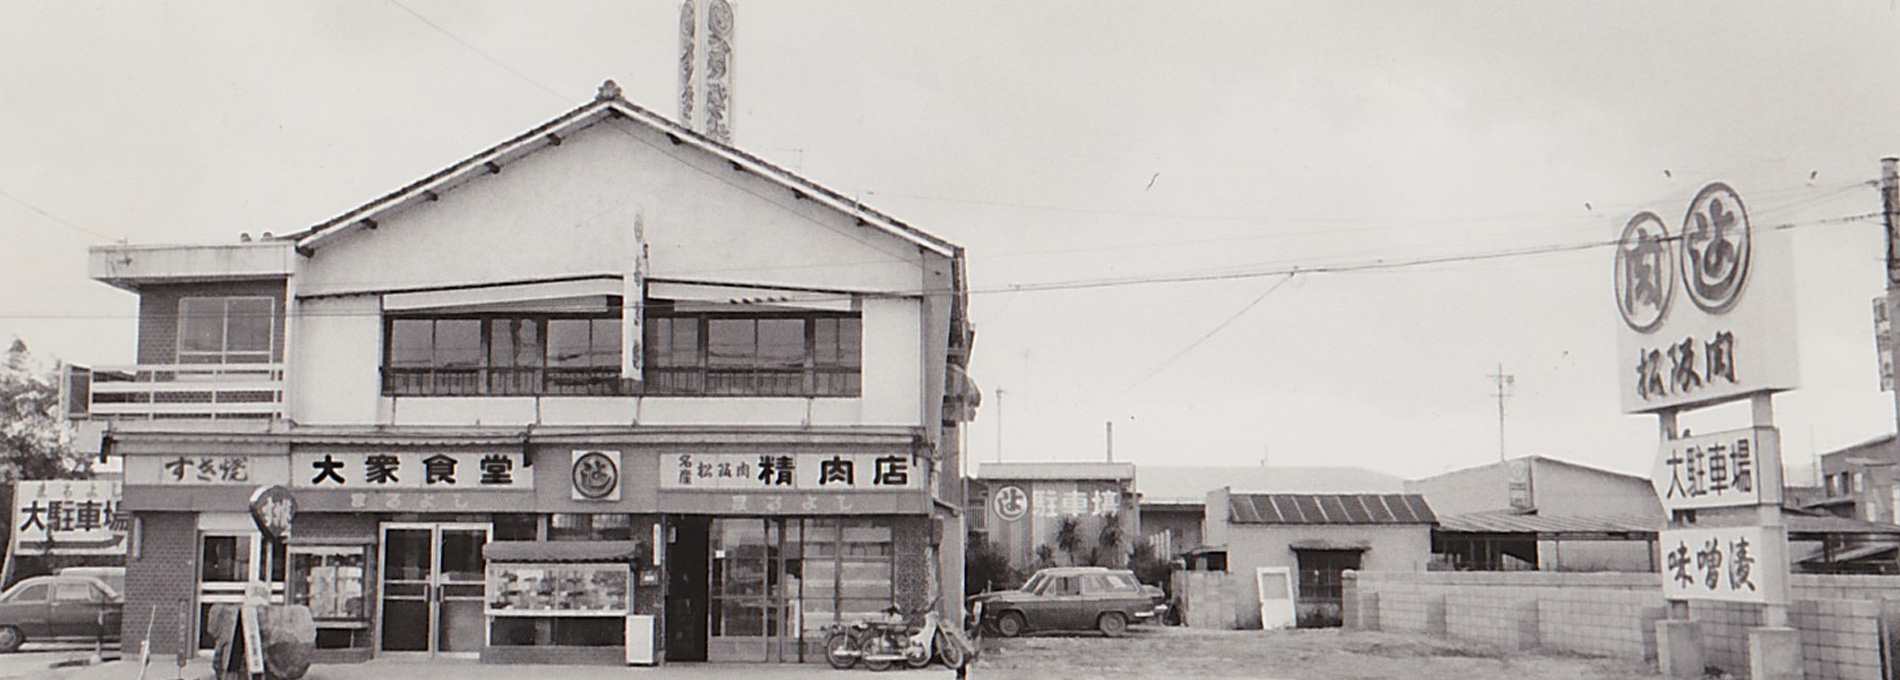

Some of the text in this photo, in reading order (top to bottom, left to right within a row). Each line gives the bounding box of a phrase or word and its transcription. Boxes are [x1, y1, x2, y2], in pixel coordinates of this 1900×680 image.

[1636, 330, 1740, 402] 松阪肉
[165, 456, 248, 482] すき焼
[311, 454, 513, 485] 大衆食堂
[678, 455, 693, 484] 名産
[757, 455, 908, 485] 精肉店
[1665, 438, 1752, 500] 大駐車場
[350, 492, 468, 509] まるよし
[731, 495, 853, 510] まるよし
[1033, 490, 1121, 519] 駐車場
[19, 500, 129, 532] 大駐車場
[1667, 535, 1756, 592] 味噌漬
